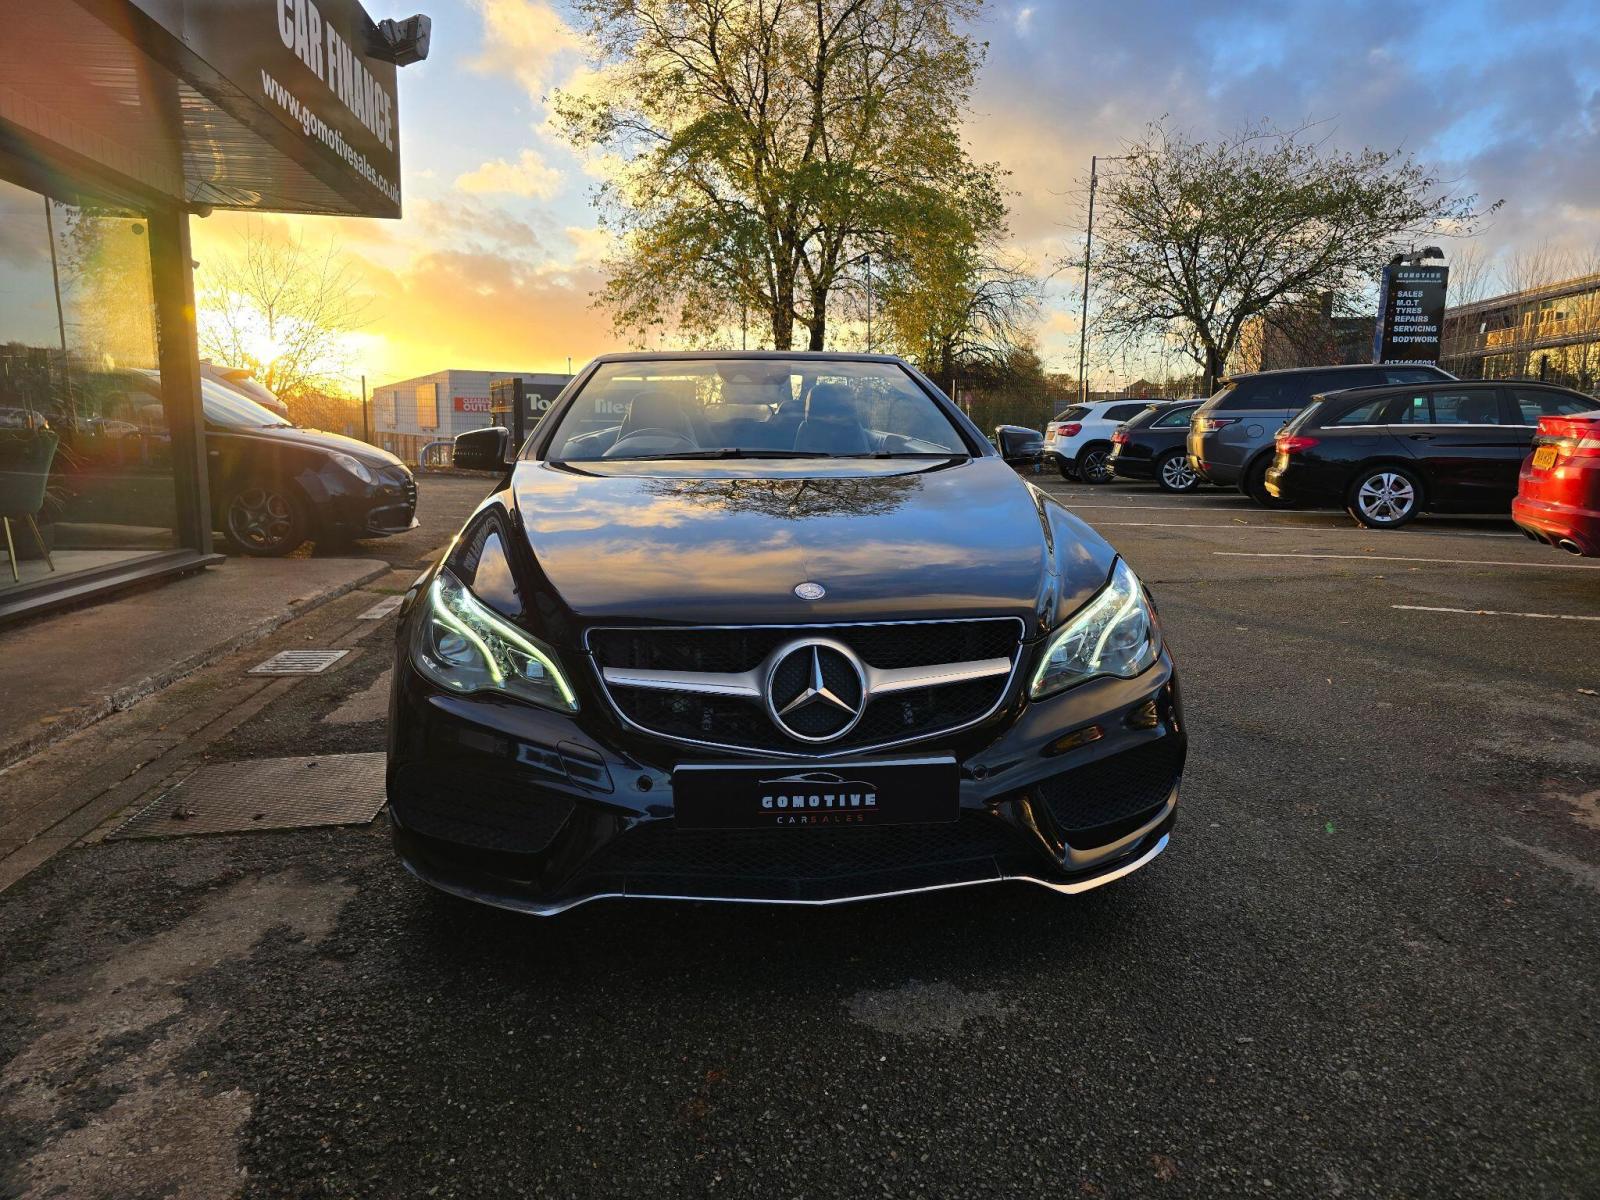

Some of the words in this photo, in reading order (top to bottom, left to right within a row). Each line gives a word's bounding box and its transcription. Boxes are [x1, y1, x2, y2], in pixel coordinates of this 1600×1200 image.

[277, 0, 324, 82] CAR
[326, 21, 393, 152] FINANCE
[261, 68, 401, 206] www.gomotivesales.co.uk
[1397, 290, 1424, 298] SALES
[1394, 315, 1429, 323] REPAIRS
[761, 793, 876, 808] GOMOTIVE
